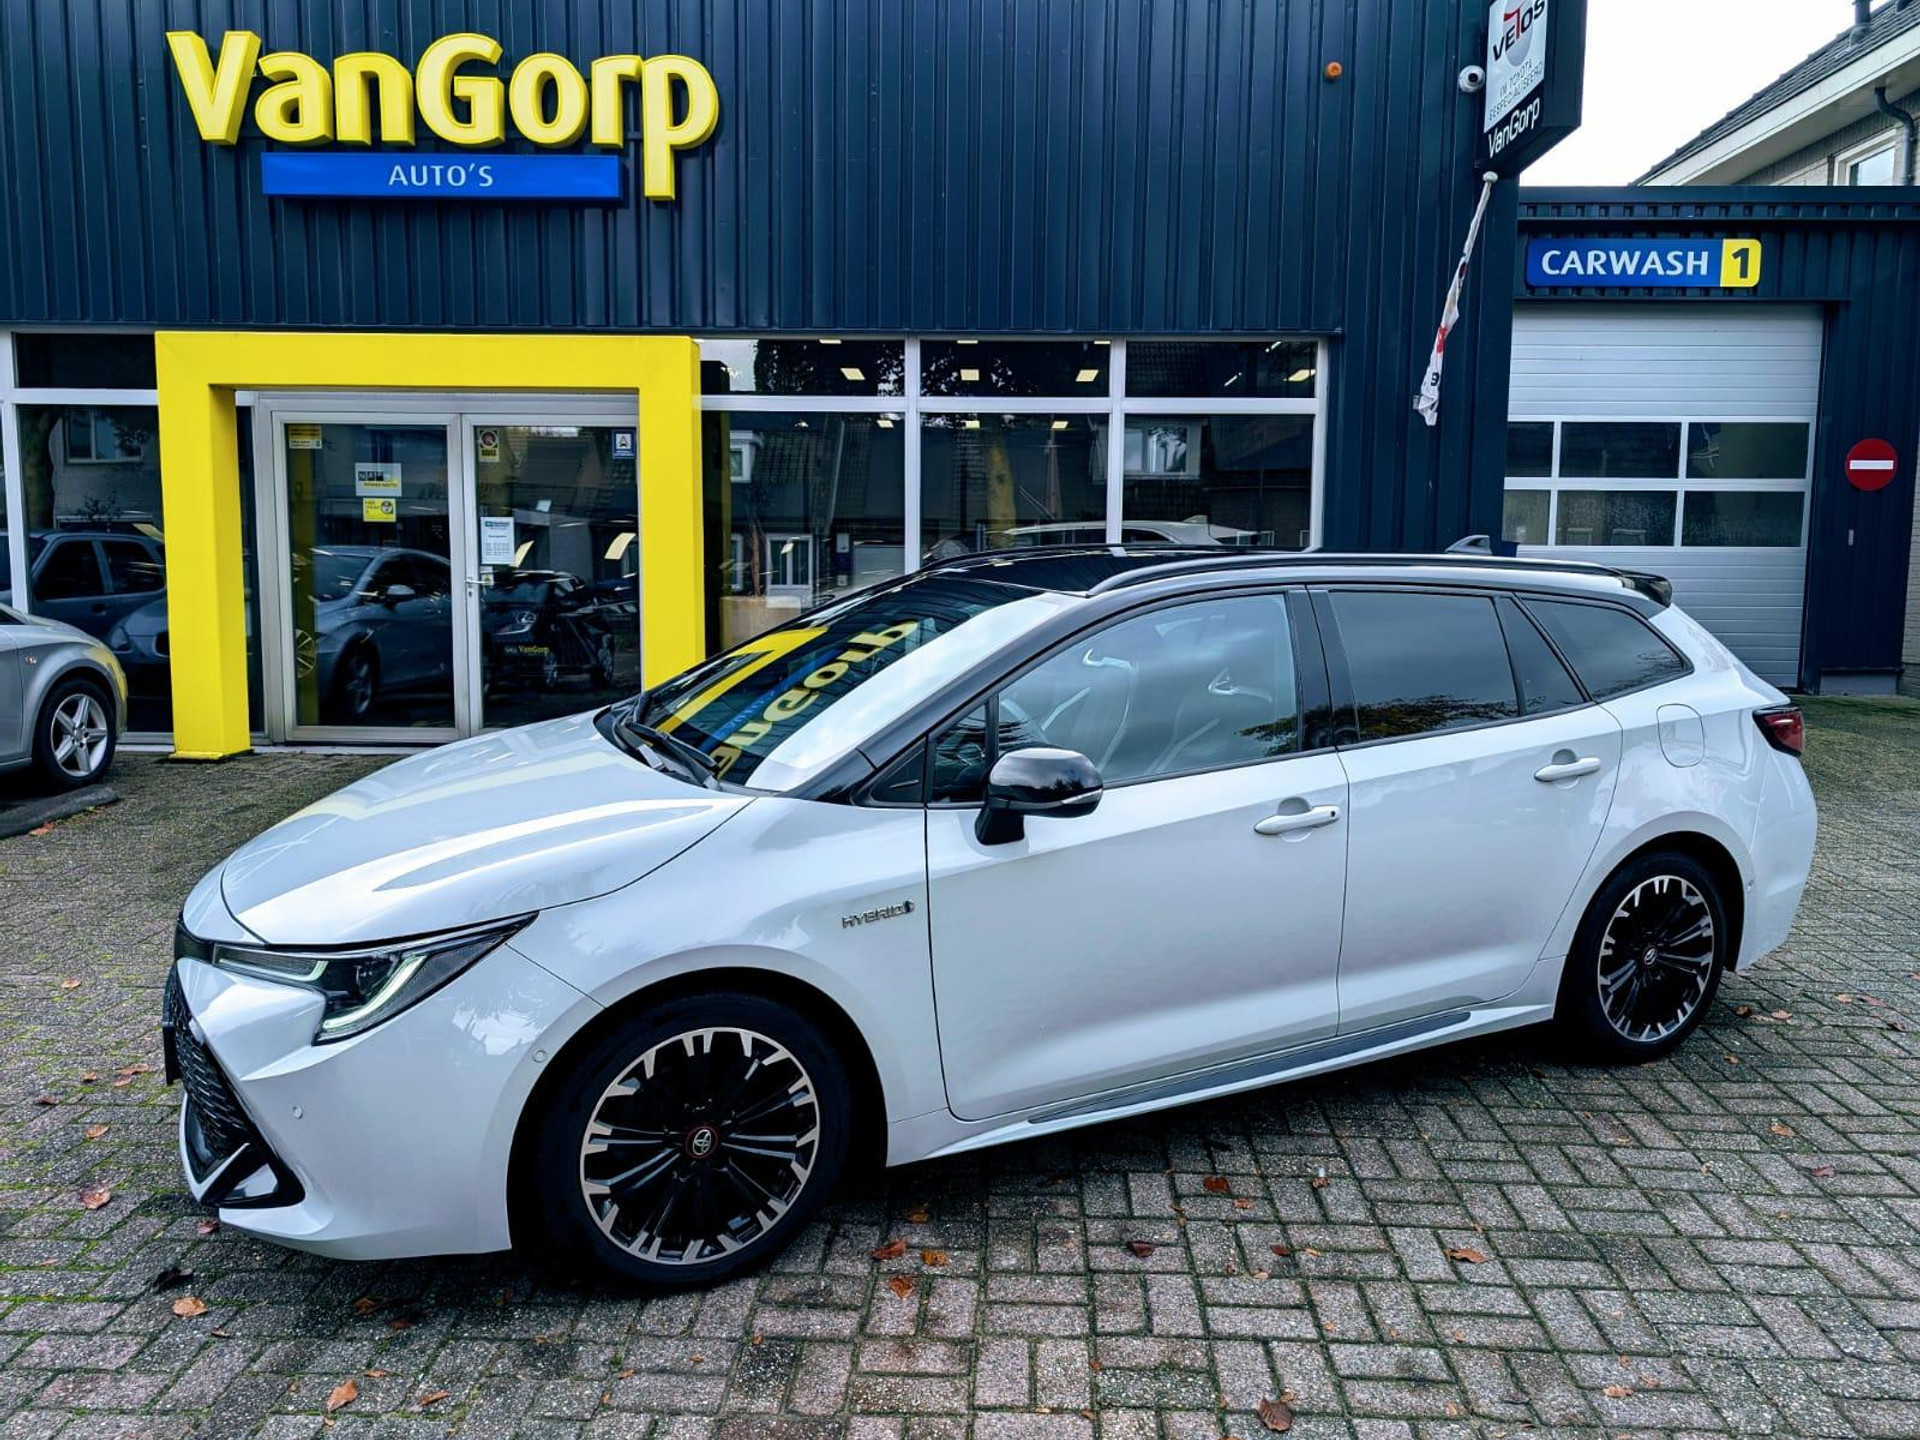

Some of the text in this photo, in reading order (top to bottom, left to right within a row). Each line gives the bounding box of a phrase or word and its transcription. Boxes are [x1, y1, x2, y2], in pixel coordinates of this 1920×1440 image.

[166, 31, 719, 199] VanGorp
[1488, 97, 1540, 159] VanGorp
[388, 162, 493, 187] AUTO'S
[1541, 247, 1750, 279] CARWASH 1
[842, 904, 904, 928] HYBRID
